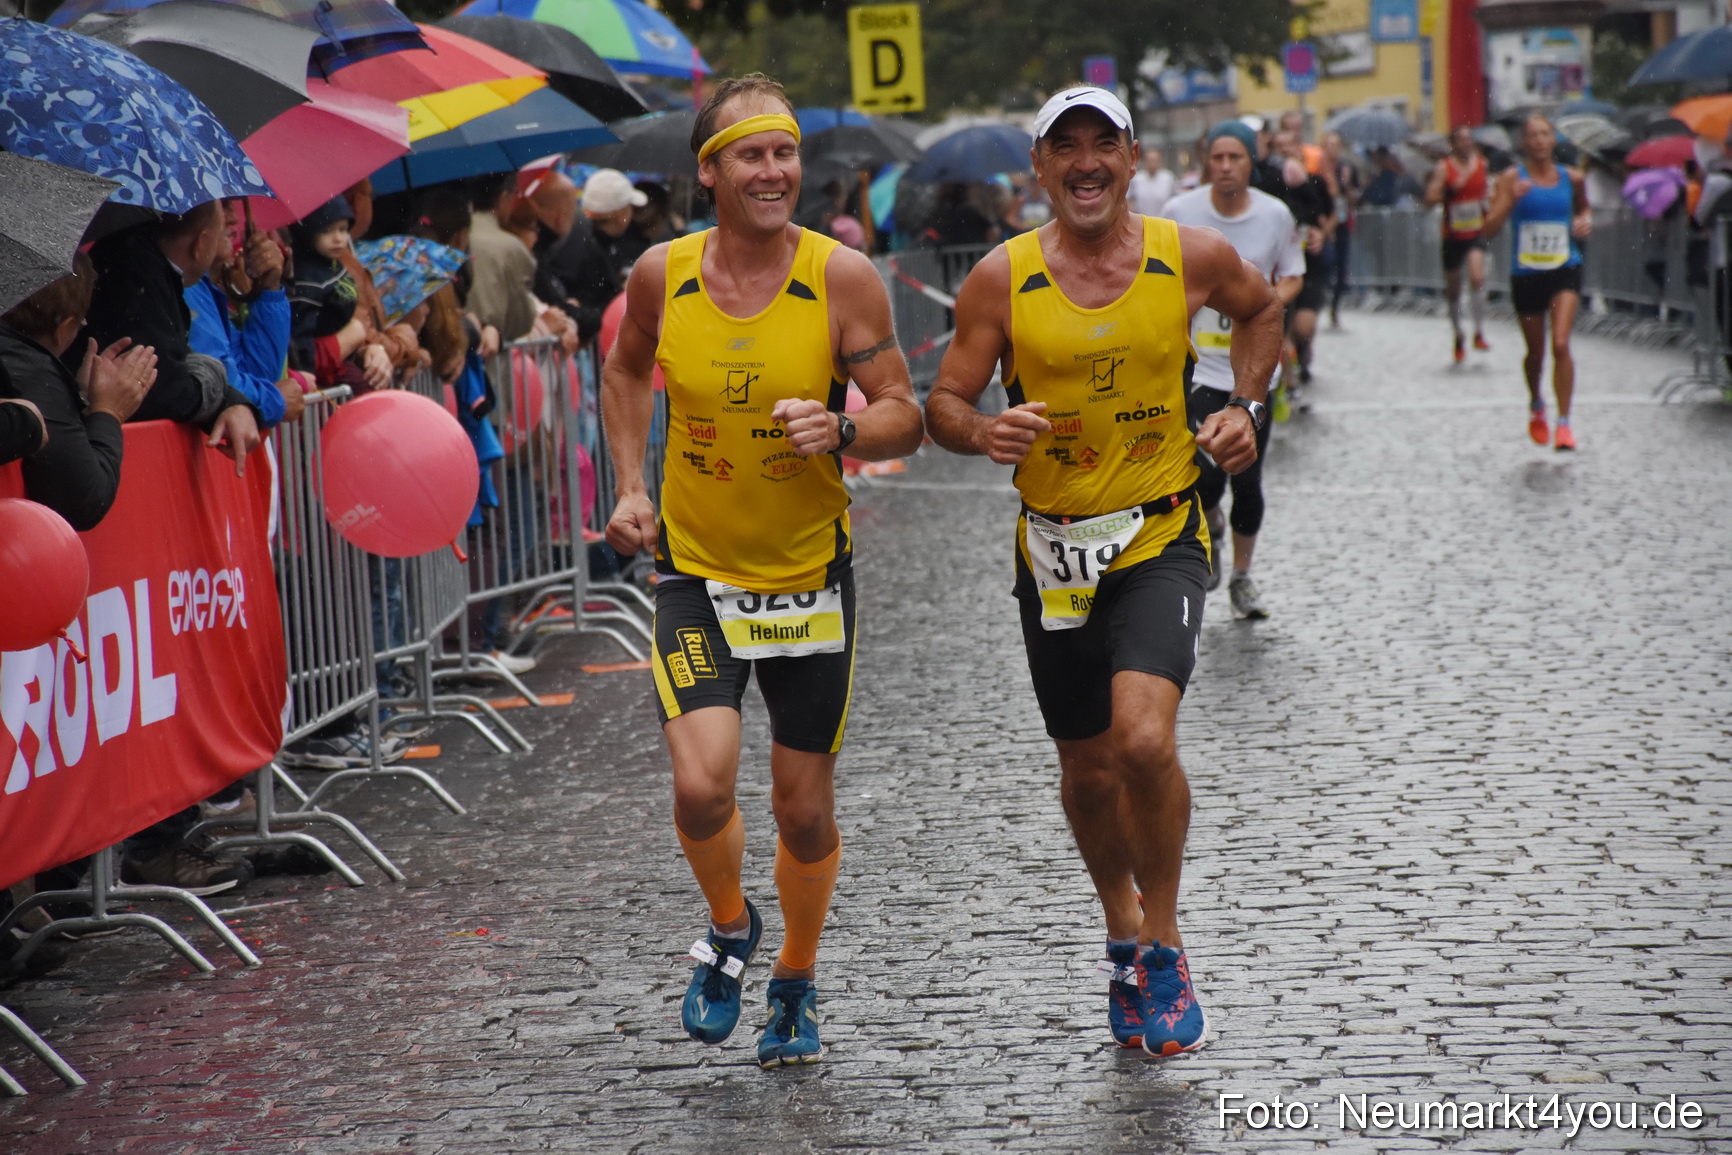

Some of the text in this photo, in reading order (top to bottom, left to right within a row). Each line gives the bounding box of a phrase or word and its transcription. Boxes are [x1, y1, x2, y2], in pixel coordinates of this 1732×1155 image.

[871, 39, 905, 88] D
[1074, 345, 1131, 362] FONDSZENTRUM
[711, 360, 765, 369] FONDSZENTRUM
[1088, 391, 1125, 404] NEUMARKT
[722, 406, 761, 414] NEUMARKT
[687, 422, 717, 440] Seidl
[1050, 418, 1083, 434] Seidl
[1124, 431, 1166, 450] PIZZERIA
[1129, 442, 1159, 457] ELIO
[772, 462, 803, 475] ELIO
[1069, 515, 1132, 540] BOCK
[750, 621, 810, 641] Helmut
[673, 654, 691, 684] Team
